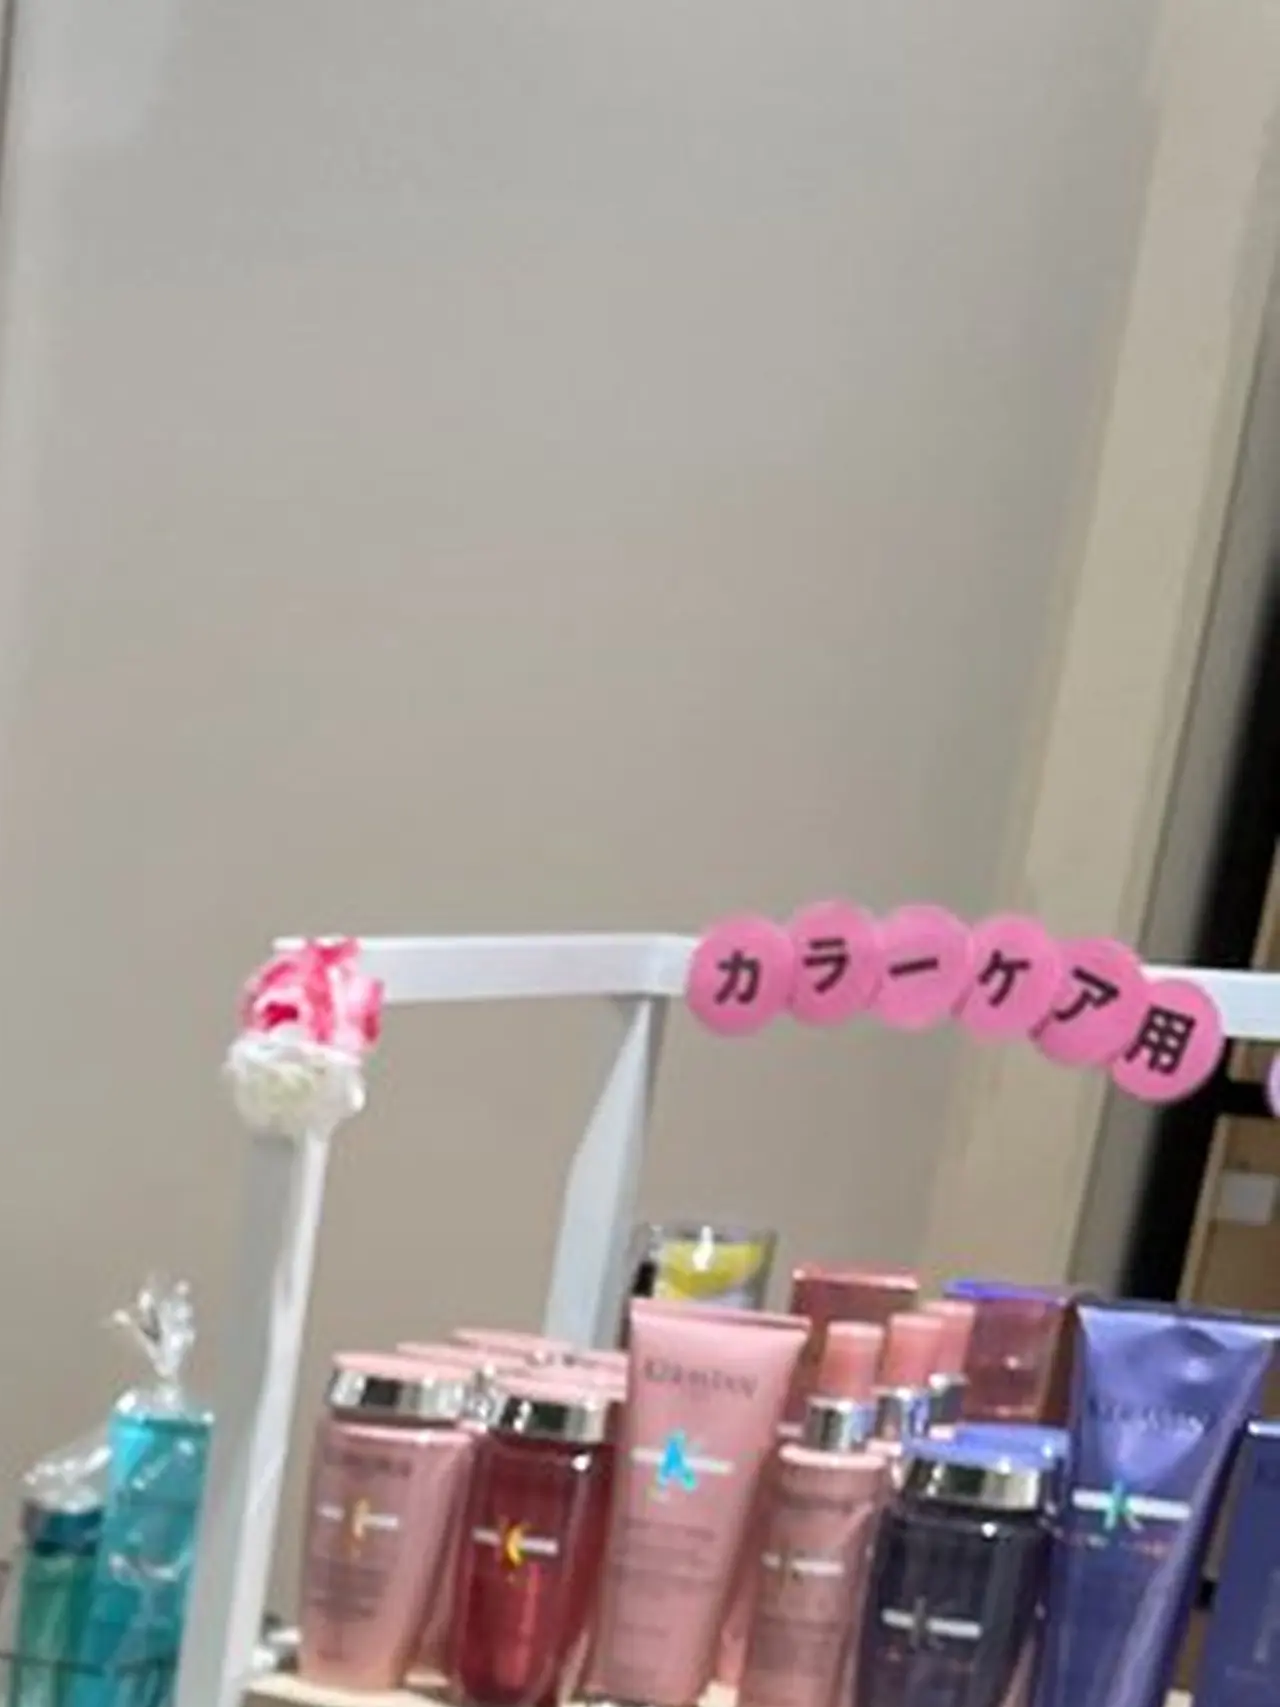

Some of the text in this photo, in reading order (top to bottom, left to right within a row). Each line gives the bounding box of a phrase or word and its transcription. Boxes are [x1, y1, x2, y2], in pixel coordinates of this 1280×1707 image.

[713, 936, 1197, 1076] カラーケア用
